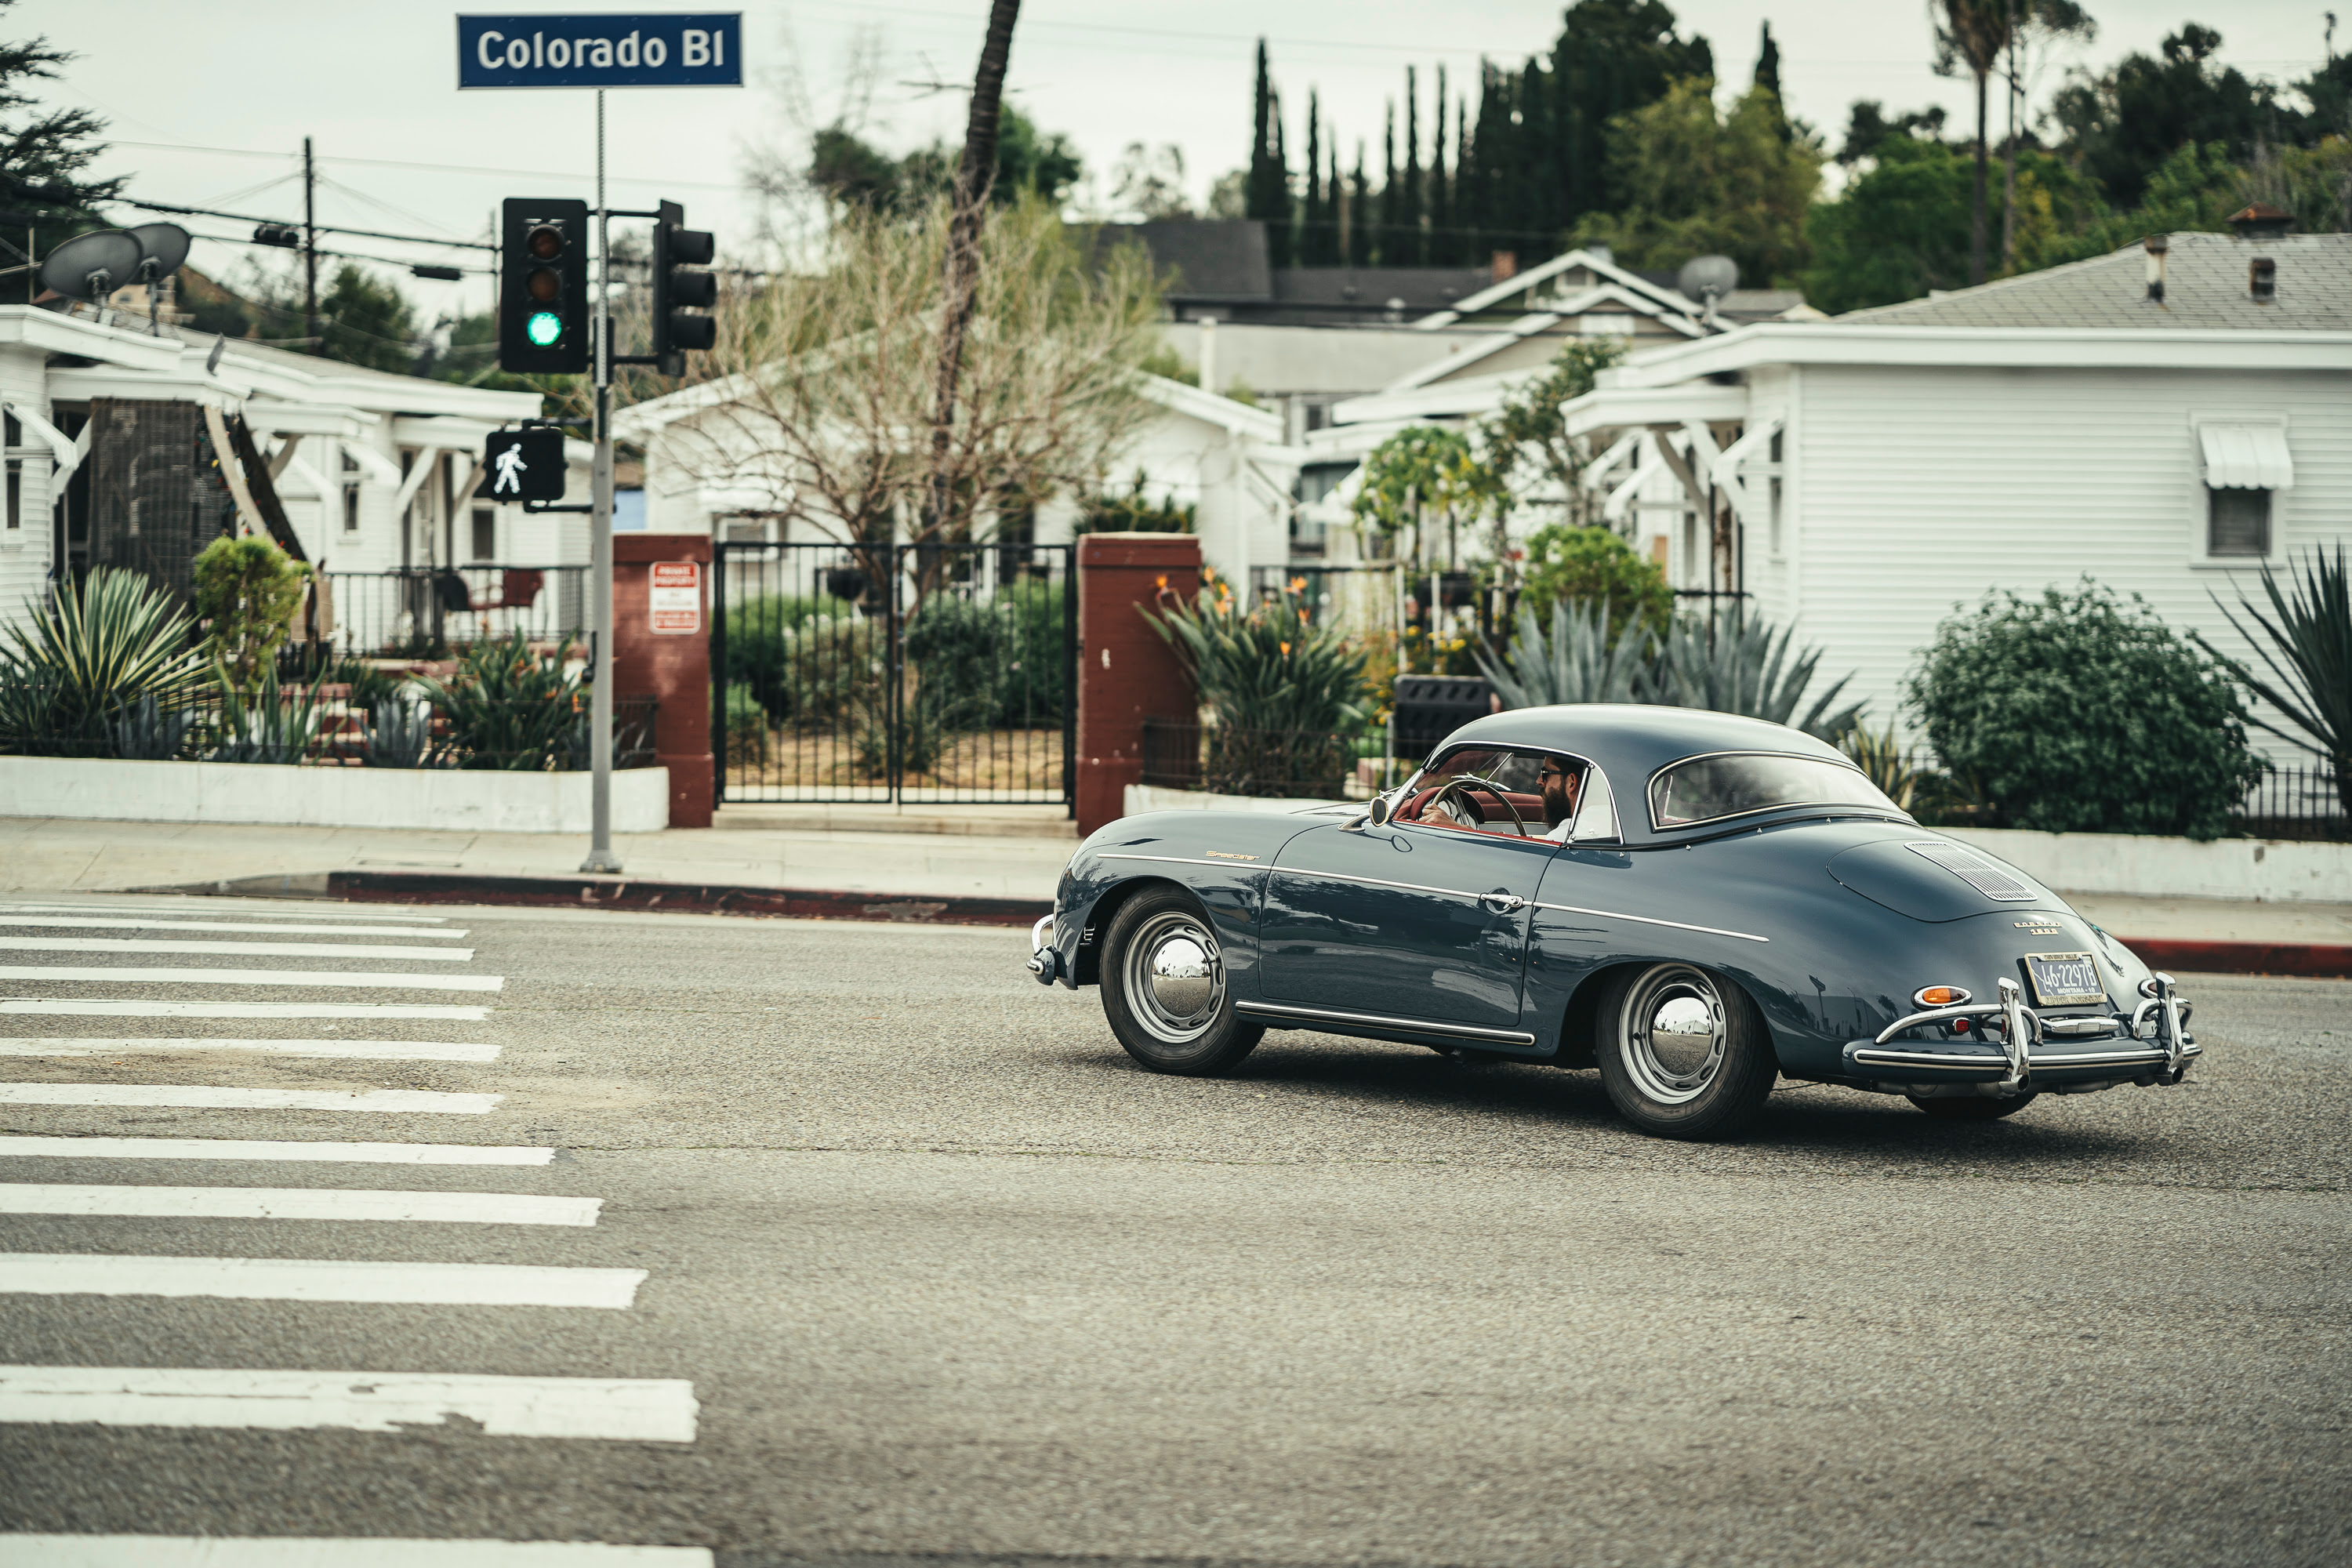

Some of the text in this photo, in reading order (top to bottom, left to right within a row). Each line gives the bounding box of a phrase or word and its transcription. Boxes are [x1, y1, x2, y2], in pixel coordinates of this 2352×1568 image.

[477, 29, 724, 69] Colorado Bl
[1206, 851, 1261, 861] Speedster
